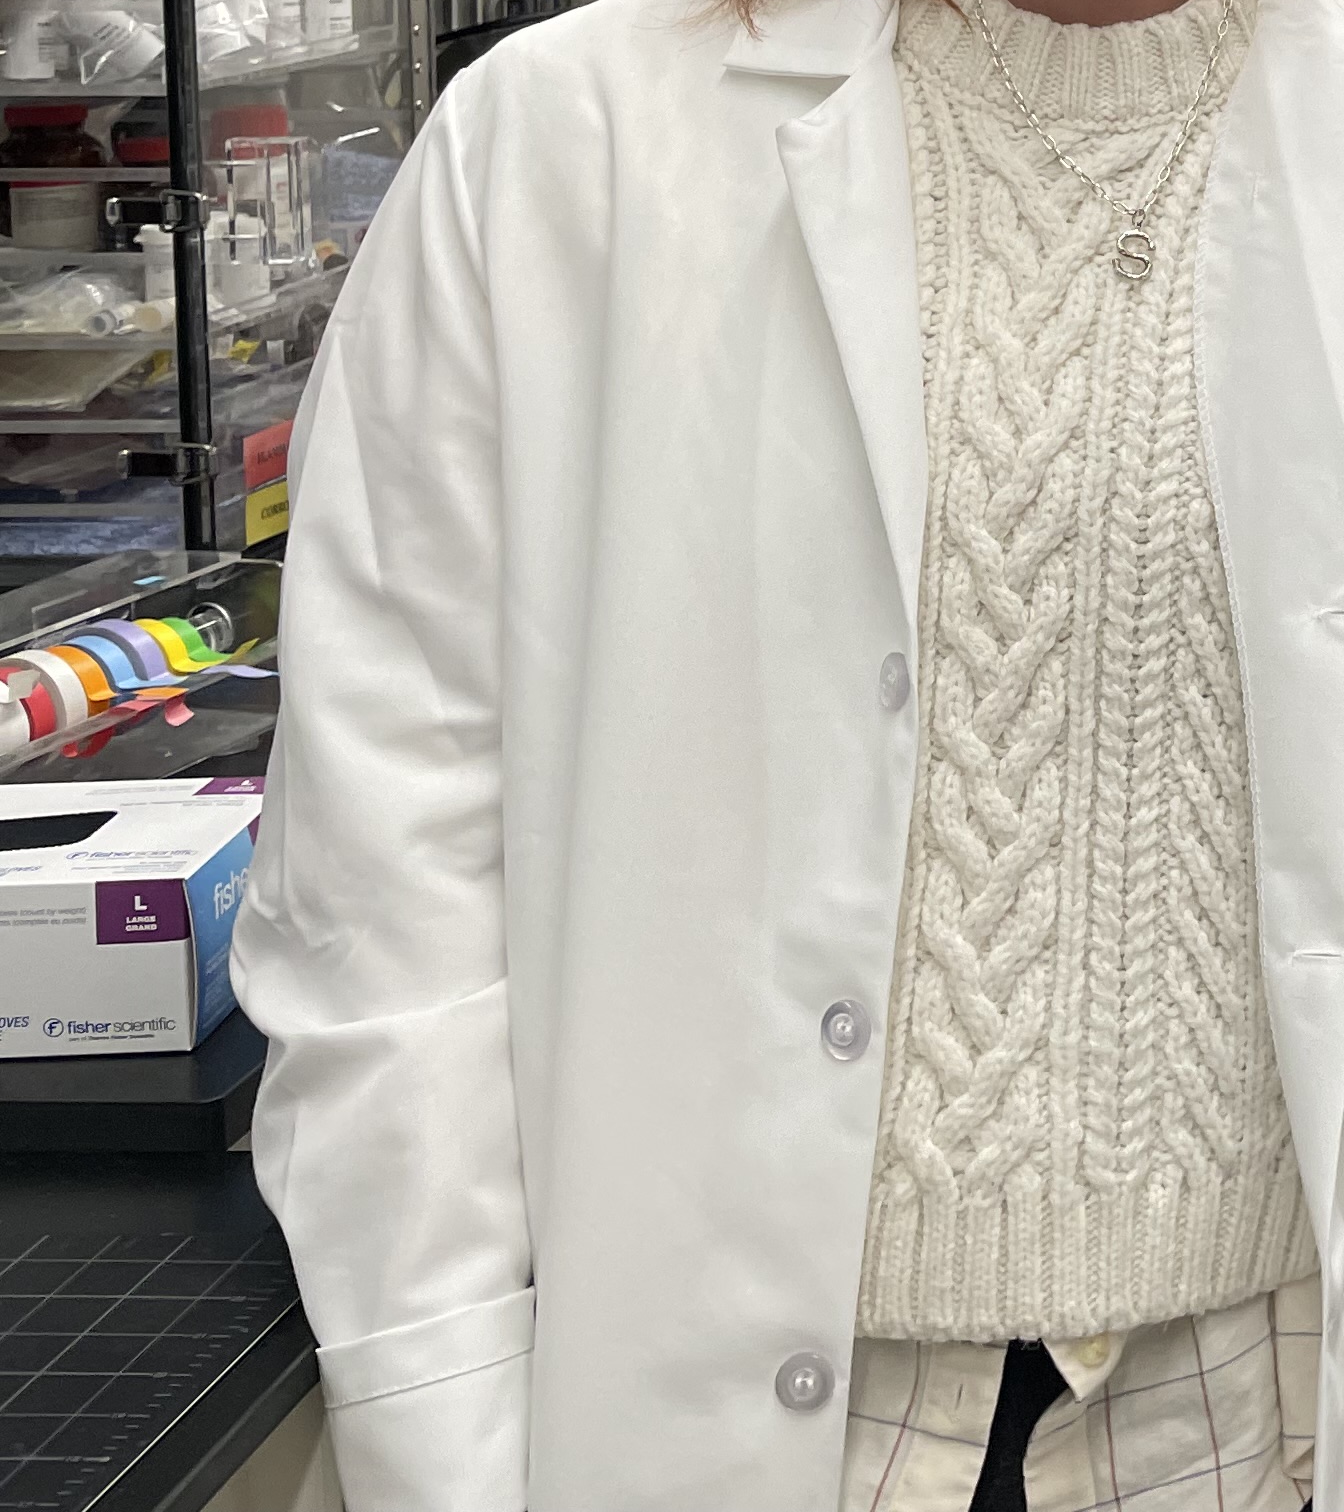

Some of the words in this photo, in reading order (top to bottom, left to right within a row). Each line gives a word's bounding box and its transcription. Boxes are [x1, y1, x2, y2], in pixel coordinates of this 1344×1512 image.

[134, 895, 148, 911] L
[125, 915, 156, 924] LARGE
[125, 923, 158, 932] GRAND
[67, 1020, 111, 1034] fisher
[113, 1017, 176, 1033] scientific
